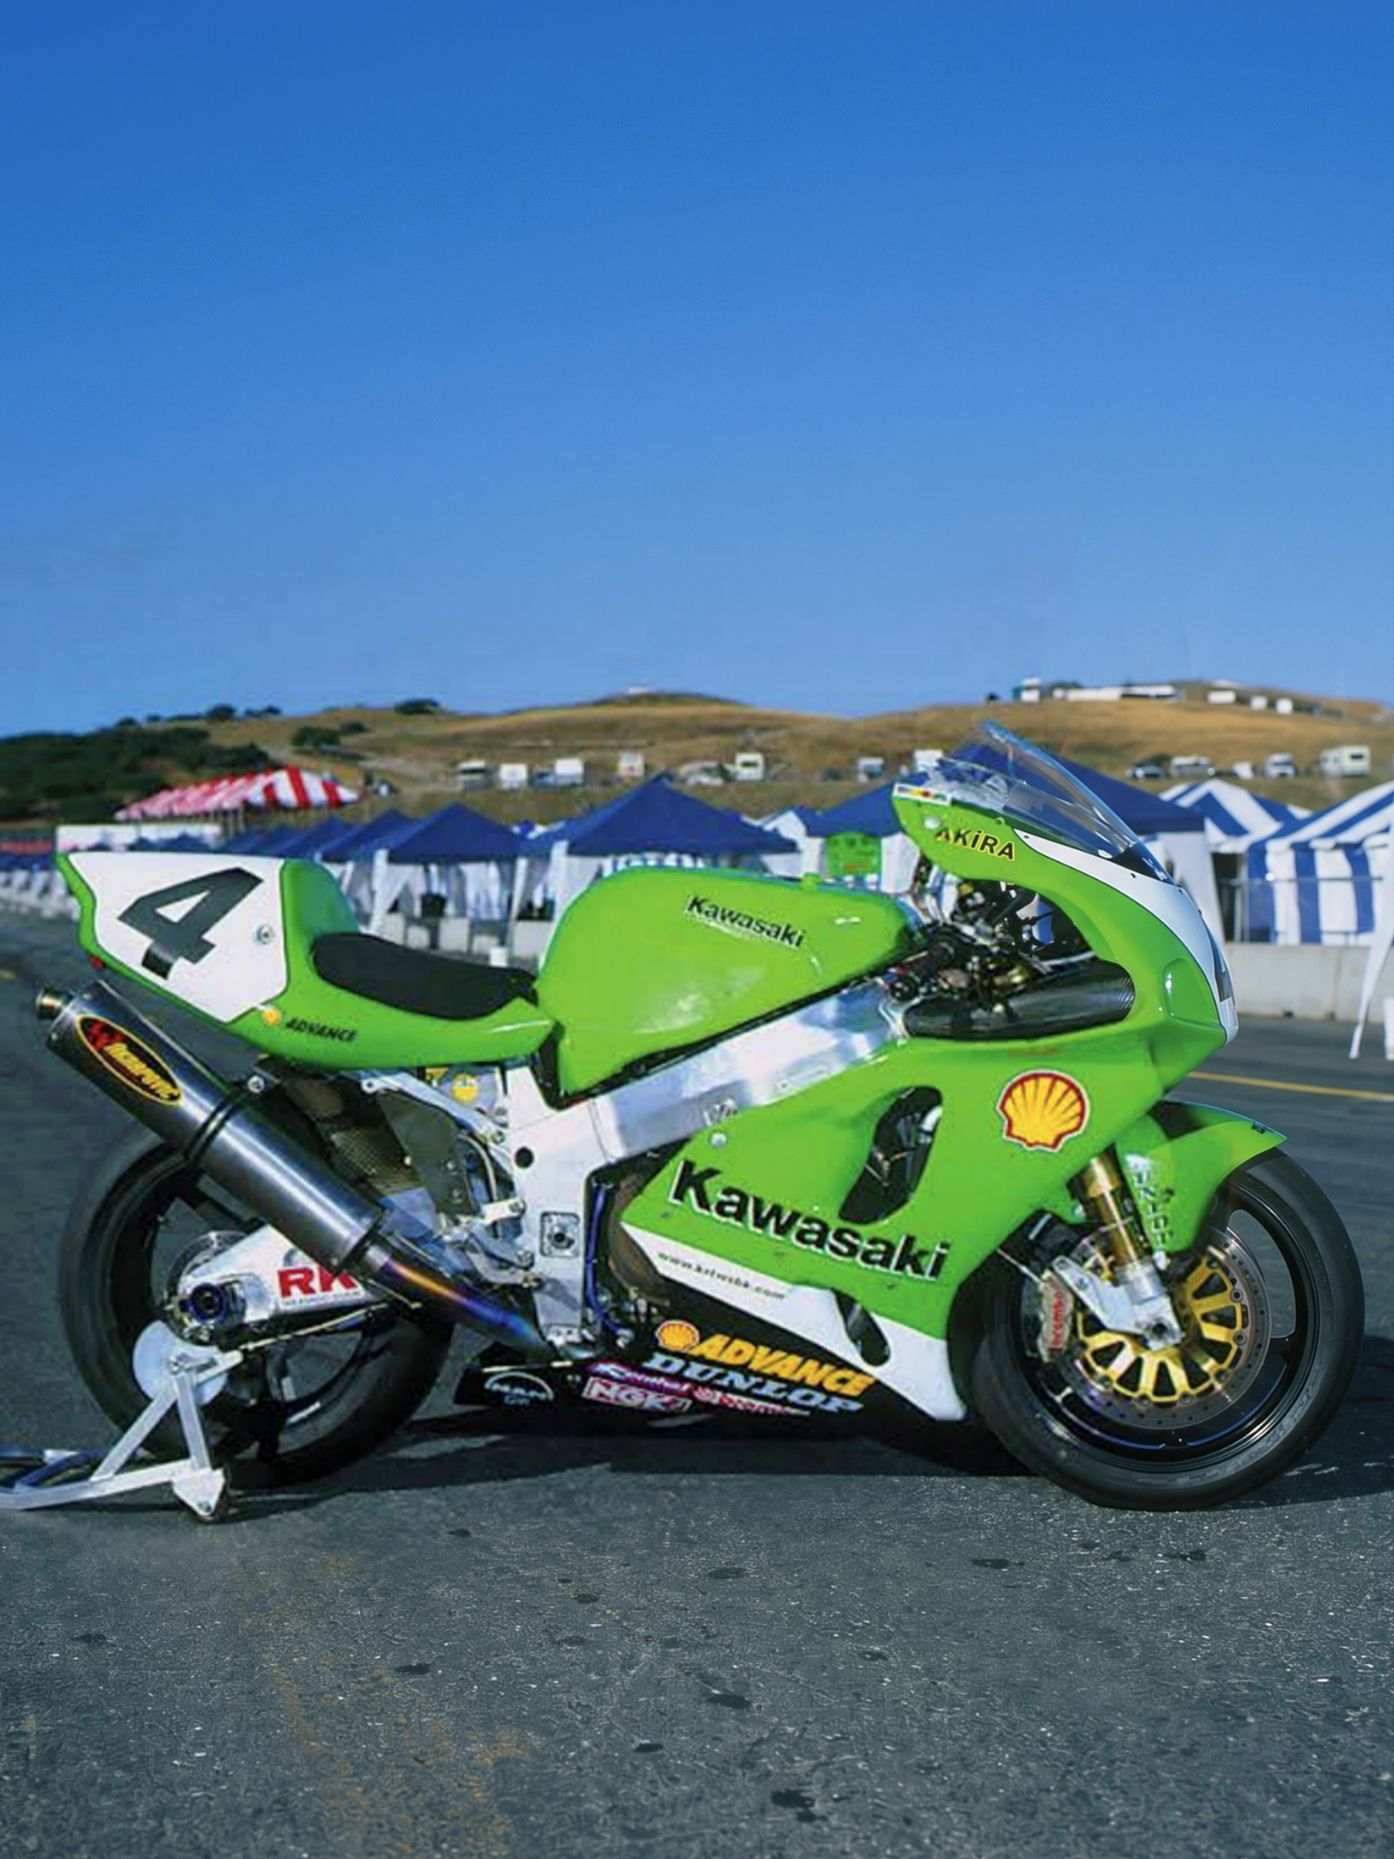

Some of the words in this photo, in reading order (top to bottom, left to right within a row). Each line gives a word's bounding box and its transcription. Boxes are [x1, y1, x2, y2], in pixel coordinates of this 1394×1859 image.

[118, 867, 263, 980] 4
[687, 896, 807, 948] Kawasaki
[285, 1017, 358, 1041] ADVANCE
[669, 1159, 950, 1280] Kawasaki
[277, 1265, 358, 1297] RK
[642, 1352, 864, 1412] DUNLOP
[688, 1333, 875, 1397] ADVANCE
[588, 1378, 680, 1412] NGK
